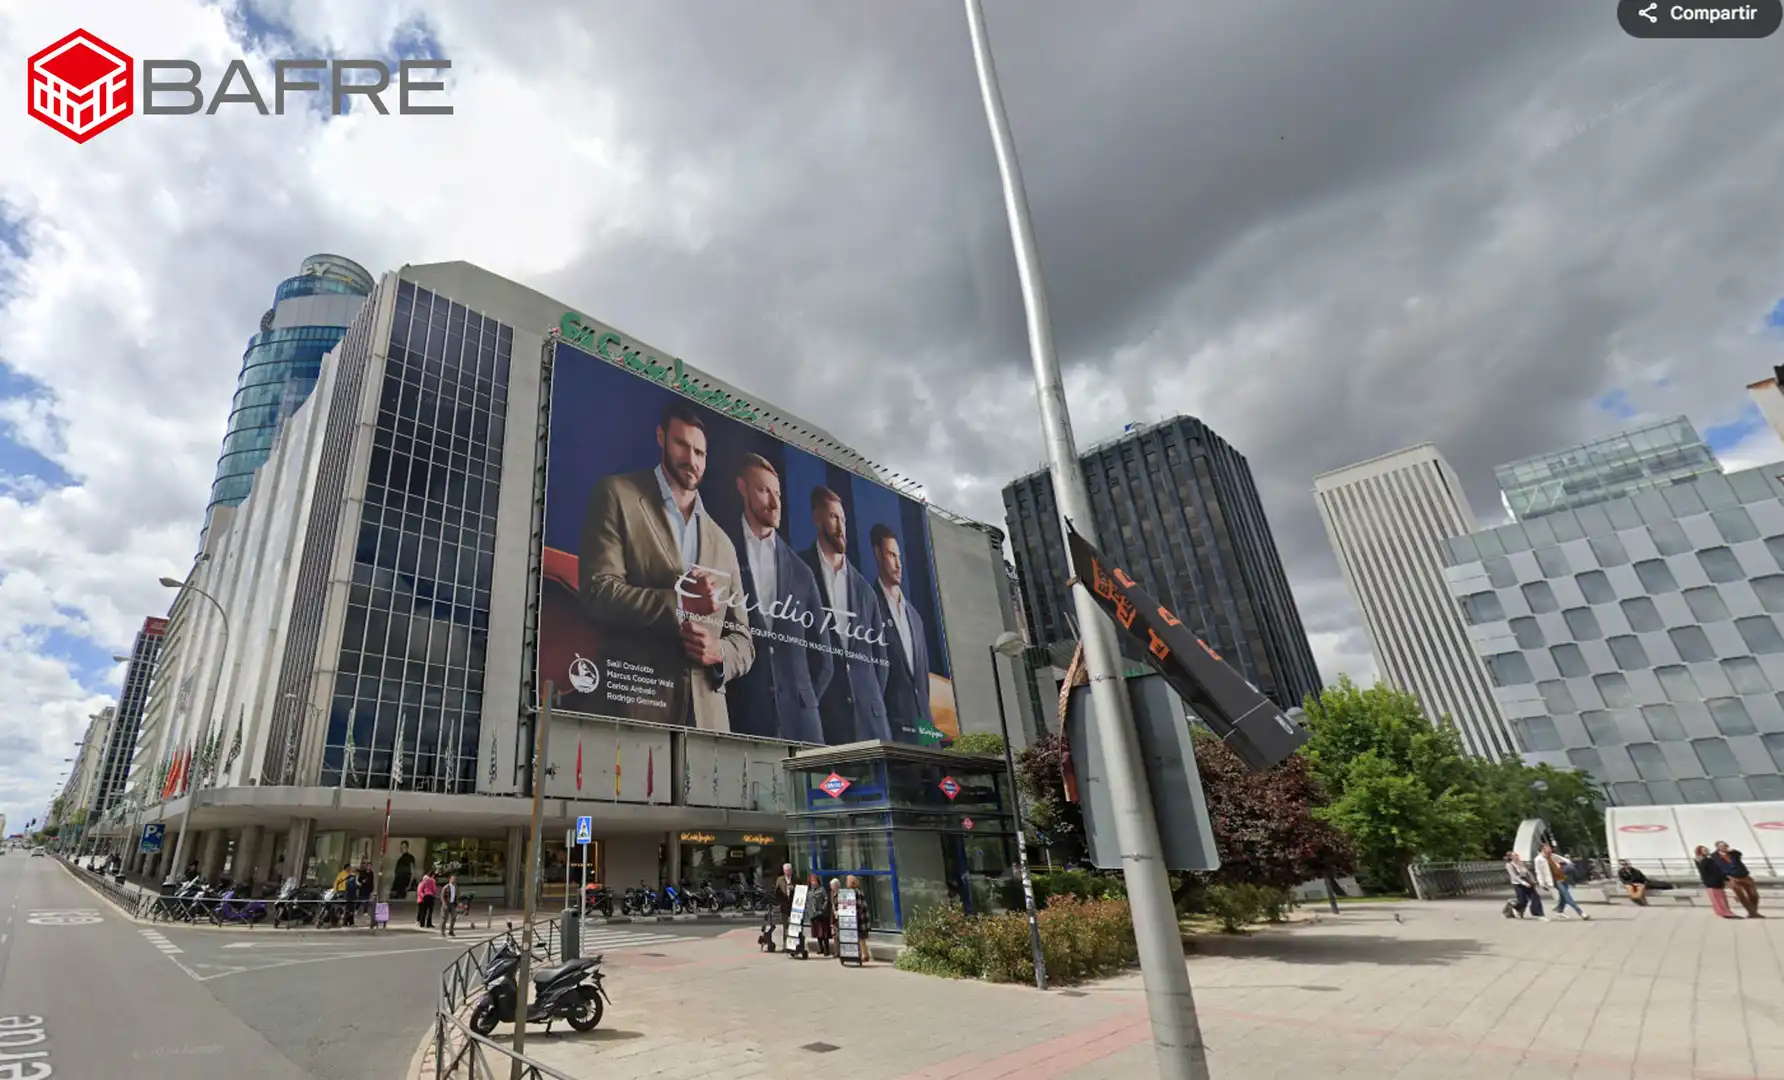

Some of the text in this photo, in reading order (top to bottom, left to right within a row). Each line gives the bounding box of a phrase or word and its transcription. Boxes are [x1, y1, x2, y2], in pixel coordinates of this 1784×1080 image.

[820, 606, 889, 647] Tucci
[750, 627, 777, 640] EQUIPO
[606, 669, 631, 681] Marcus
[632, 674, 657, 685] Cooper
[606, 681, 629, 692] Carlos
[606, 691, 635, 704] Rodrigo
[144, 825, 158, 838] P
